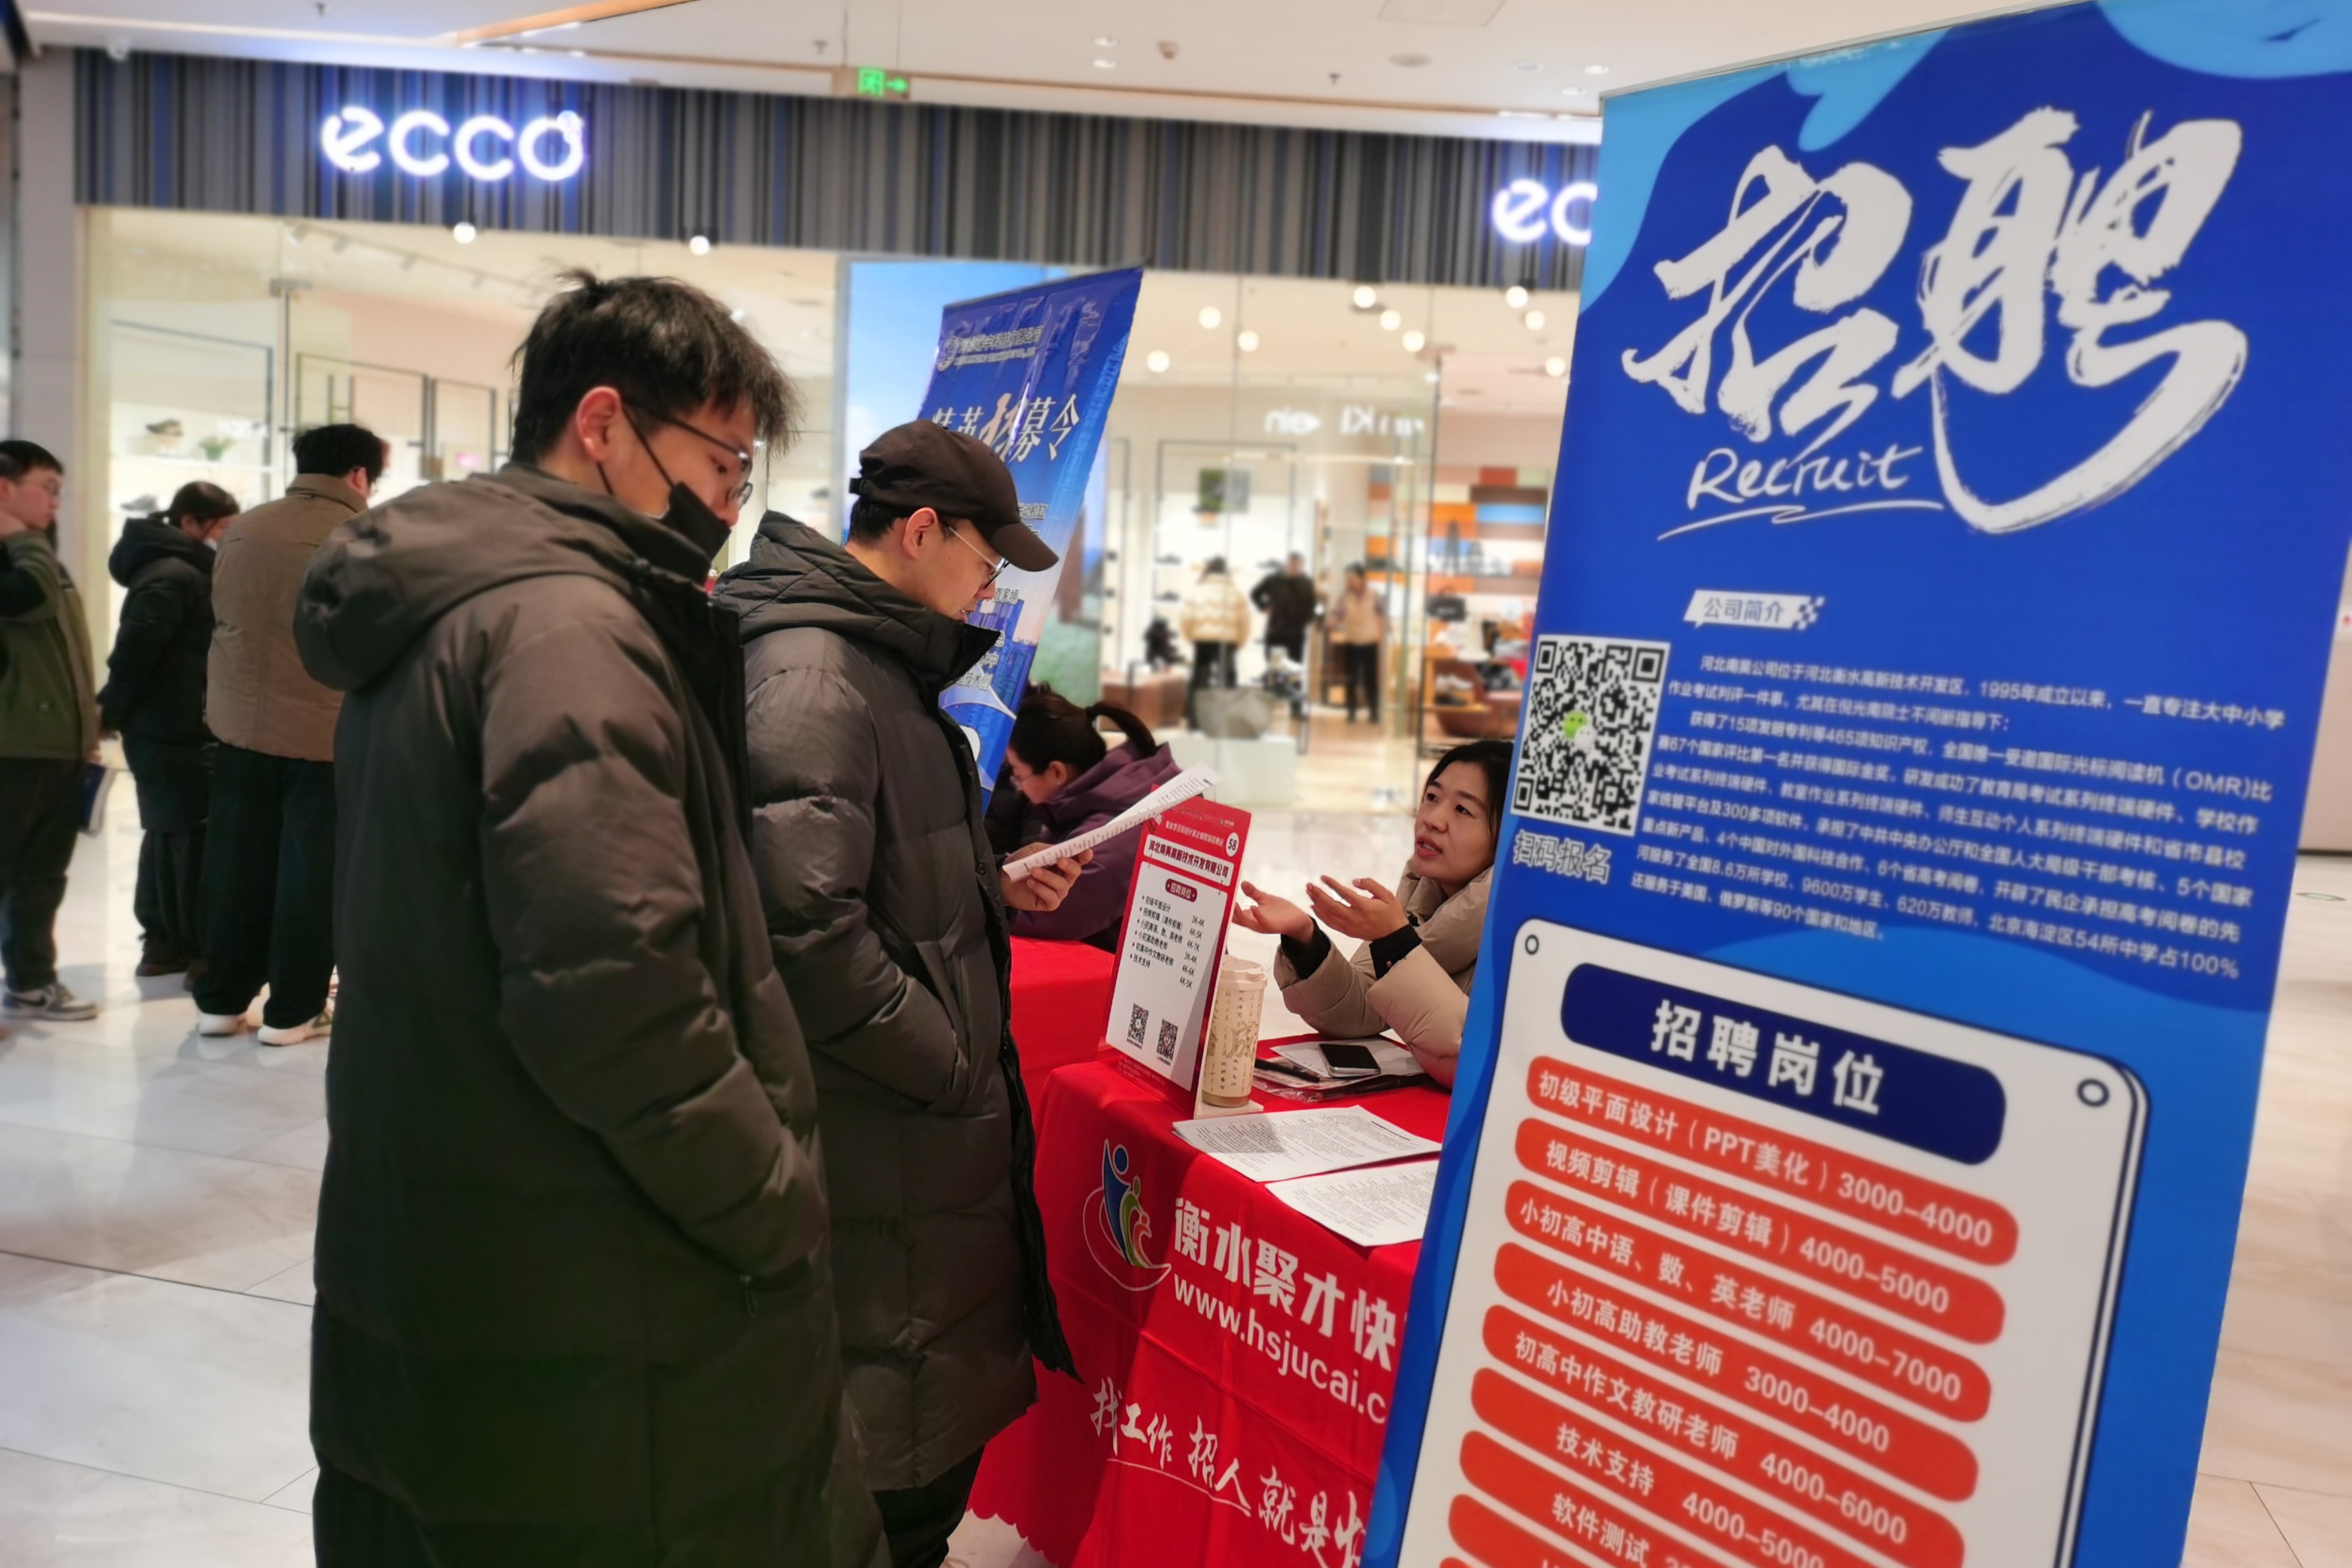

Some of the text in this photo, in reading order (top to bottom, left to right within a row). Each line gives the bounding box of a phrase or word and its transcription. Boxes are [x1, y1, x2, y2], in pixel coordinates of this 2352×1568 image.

[322, 106, 583, 181] ecco
[1622, 106, 2249, 535] 招聘
[1685, 441, 1924, 511] Recruit
[1703, 596, 1785, 623] 公司简介
[1228, 839, 1237, 851] 58
[1513, 828, 1613, 885] 扫码报名
[1146, 896, 1205, 927] 初级平面设计 3K-4K
[1170, 883, 1191, 899] 招聘岗位
[1184, 952, 1197, 964] 3K-4K
[1187, 940, 1200, 952] 4K-7K
[1190, 928, 1203, 939] 4K-5K
[1133, 954, 1193, 989] 技术支持 4K-5K
[1182, 965, 1195, 977] 4K-6K
[1650, 999, 1885, 1115] 招聘岗位
[1173, 1197, 1407, 1372] 衡水聚才快
[1520, 1198, 1796, 1333] 小初高中语、数、英老师
[1809, 1317, 1962, 1402] 4000-7000
[1173, 1272, 1386, 1424] www.hsjucai.c
[1547, 1279, 1890, 1453] 小初高助教老师 3000-4000
[1090, 1375, 1173, 1469] 找工作
[1186, 1414, 1251, 1510] 招人
[1514, 1331, 1908, 1544] 初高中作文教研老师 4000-6000
[1556, 1423, 1656, 1496] 技术支持
[1553, 1493, 1650, 1567] 软件测试
